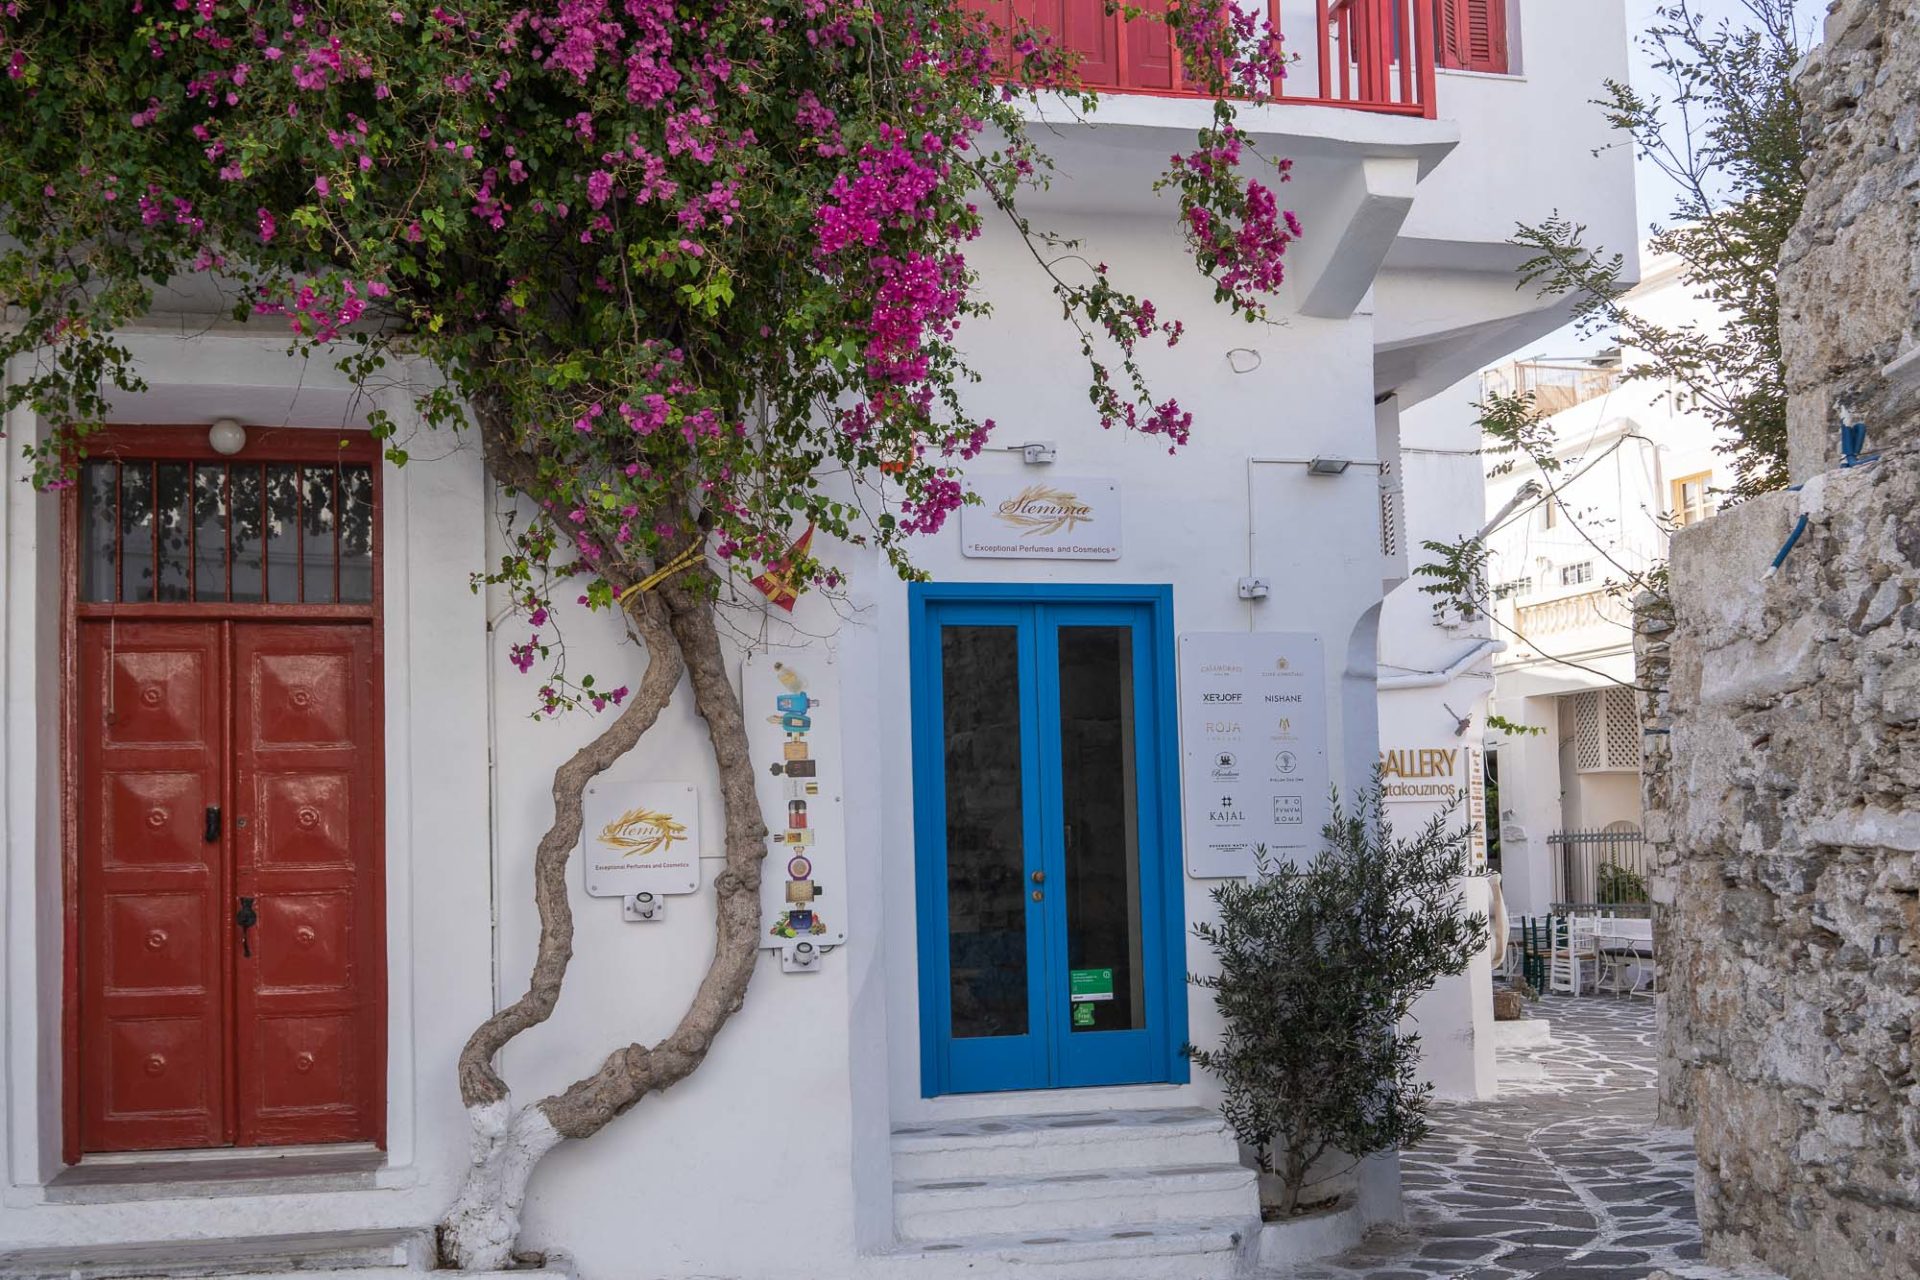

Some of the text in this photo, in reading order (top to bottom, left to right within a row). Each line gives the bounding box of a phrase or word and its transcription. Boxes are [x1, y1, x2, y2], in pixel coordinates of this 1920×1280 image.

[999, 494, 1091, 516] Stemma
[974, 544, 1111, 554] Exceptional Perfumes and Cosmetics
[1203, 693, 1243, 702] XERJOFF
[1264, 694, 1303, 703] NISHANE
[1206, 721, 1241, 733] ROJA
[1209, 811, 1246, 822] KAJAL
